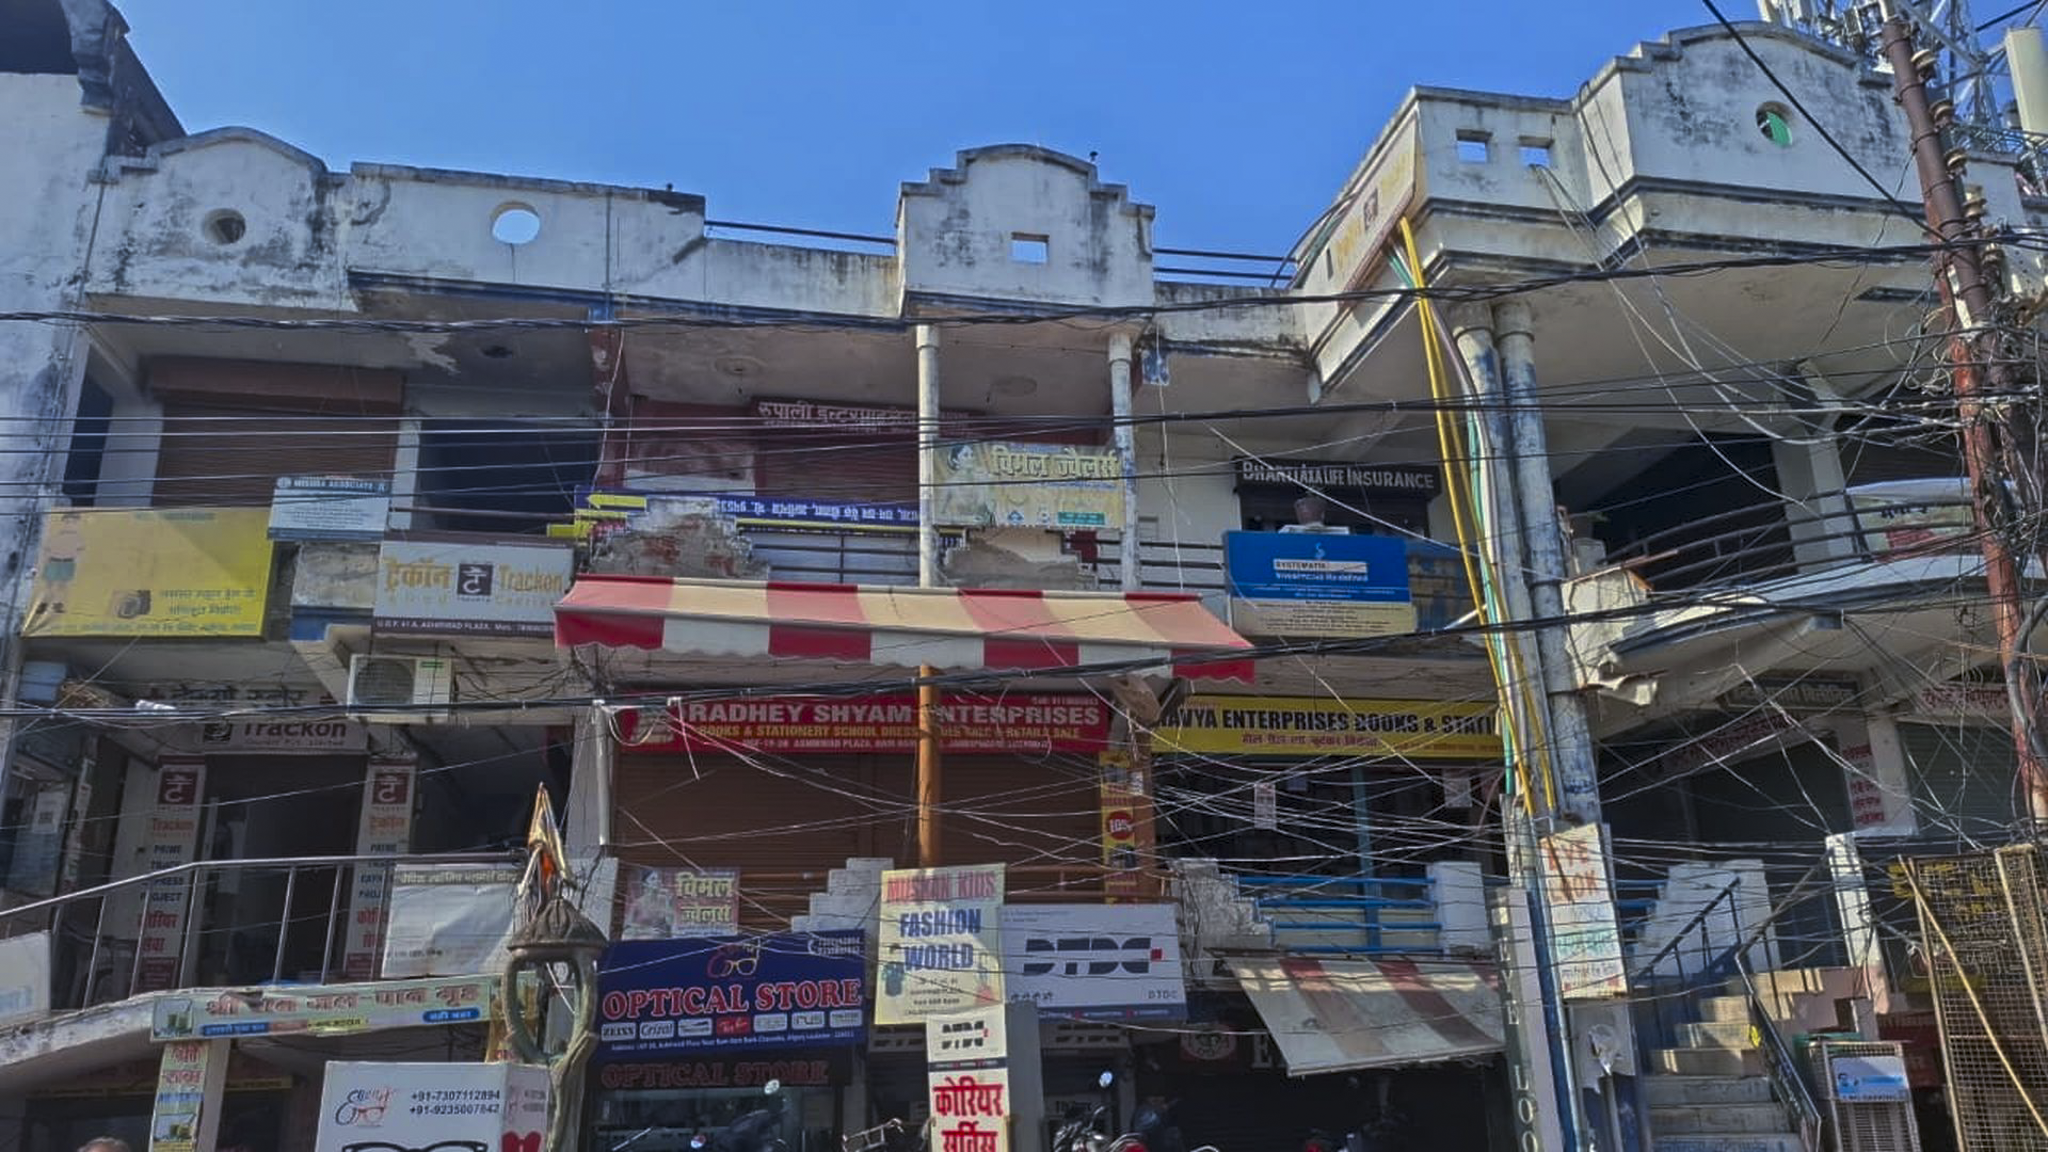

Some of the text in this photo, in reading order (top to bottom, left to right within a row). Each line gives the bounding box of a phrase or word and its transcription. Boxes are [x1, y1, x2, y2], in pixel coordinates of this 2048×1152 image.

[1347, 467, 1434, 488] INSURANCE
[498, 562, 565, 592] Trackon
[688, 704, 1100, 725] RADHEY SHYAM NTERPRISES
[1222, 710, 1348, 732] ENTERPRISES
[1355, 713, 1418, 734] BOOKS
[756, 726, 829, 739] STATIONERY
[900, 908, 982, 938] FASHION
[904, 943, 973, 971] WORLD
[1024, 937, 1151, 976] DTDC
[603, 978, 863, 1019] OPTICAL STORE
[602, 1063, 730, 1088] OPTICAL
[932, 1076, 1005, 1117] कोरियर
